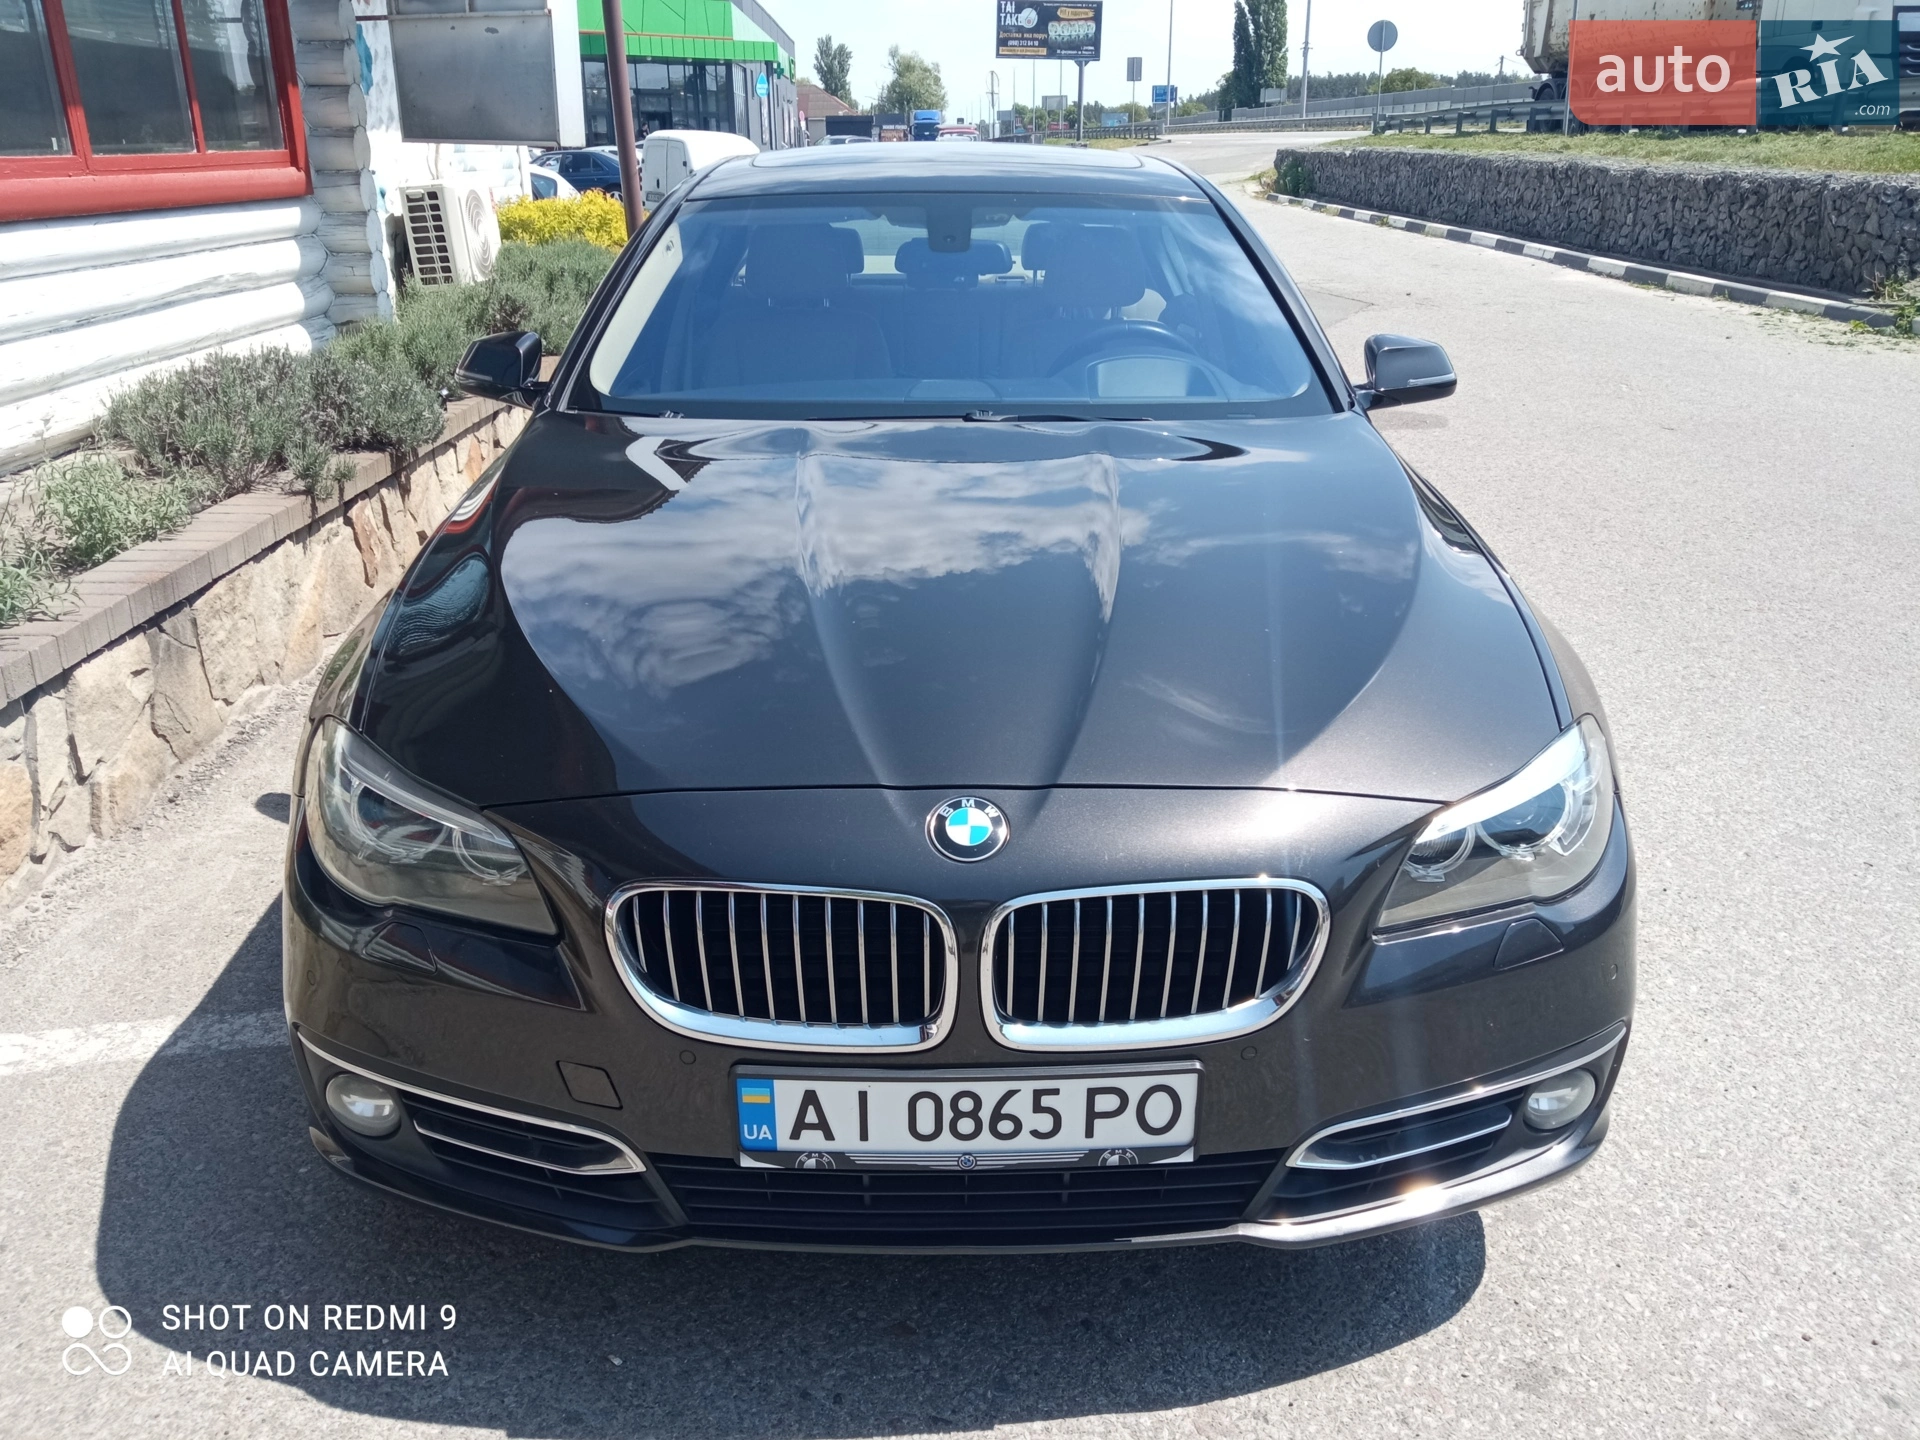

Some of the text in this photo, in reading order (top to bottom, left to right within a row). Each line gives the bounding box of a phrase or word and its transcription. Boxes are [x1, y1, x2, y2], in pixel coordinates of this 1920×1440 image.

[939, 799, 1000, 818] BMW
[744, 1084, 1182, 1142] UA AI 0865 PO
